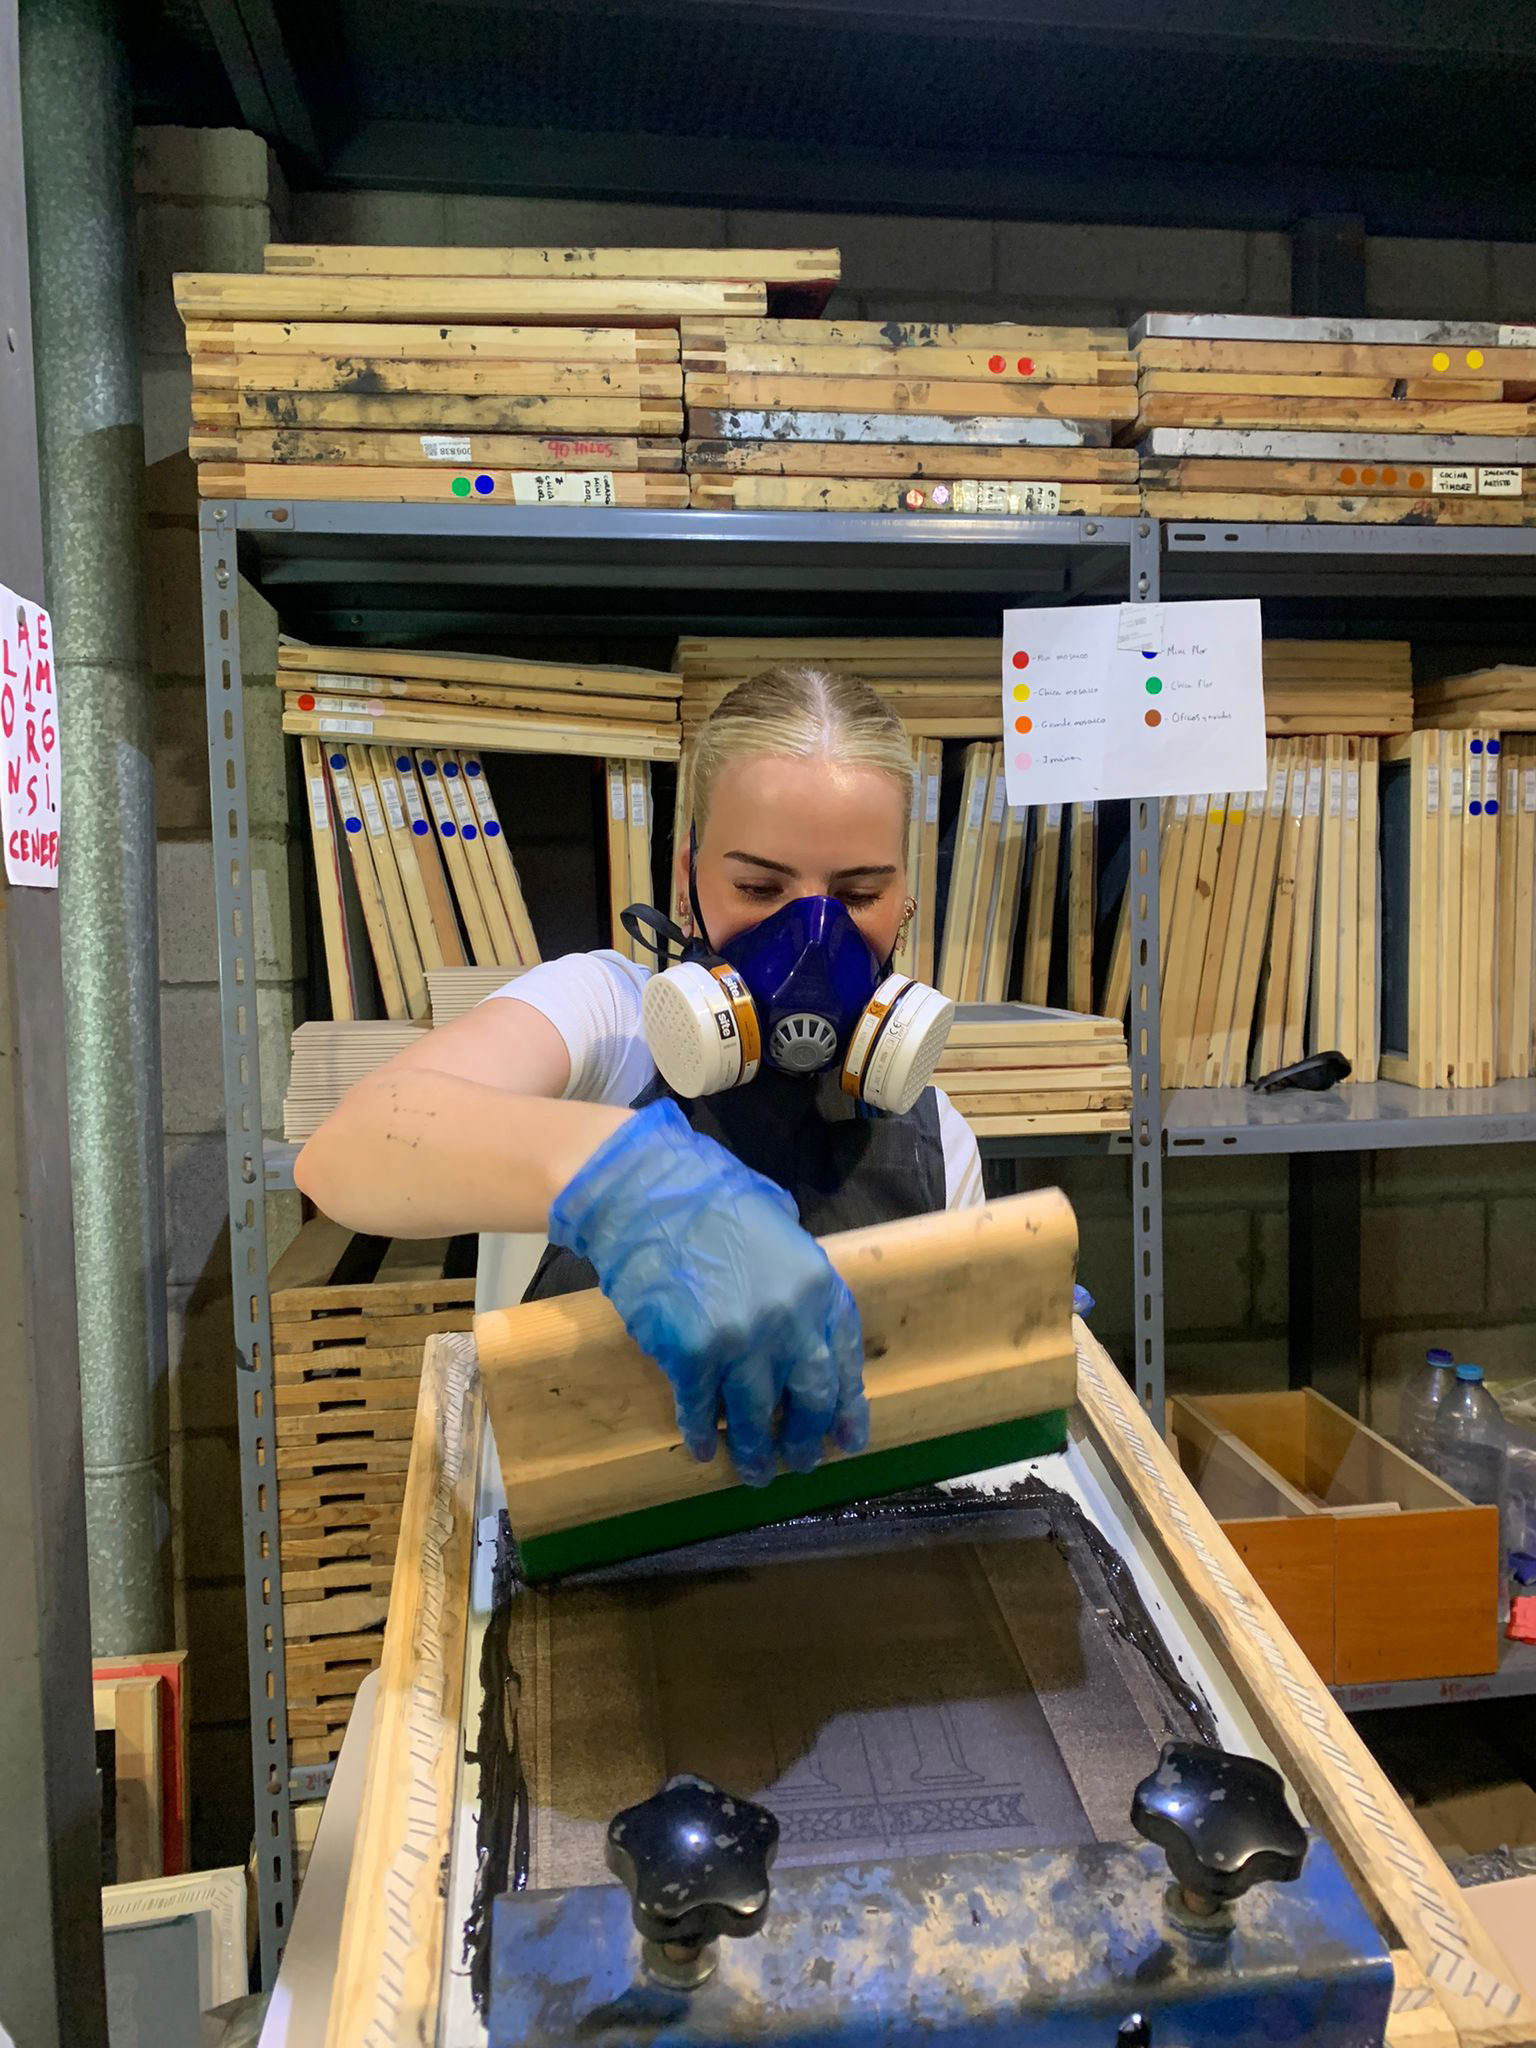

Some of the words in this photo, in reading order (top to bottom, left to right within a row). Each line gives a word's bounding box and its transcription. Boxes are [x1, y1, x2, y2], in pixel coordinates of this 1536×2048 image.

[1439, 471, 1469, 479] COCINA
[724, 975, 740, 999] site
[717, 1012, 731, 1037] site
